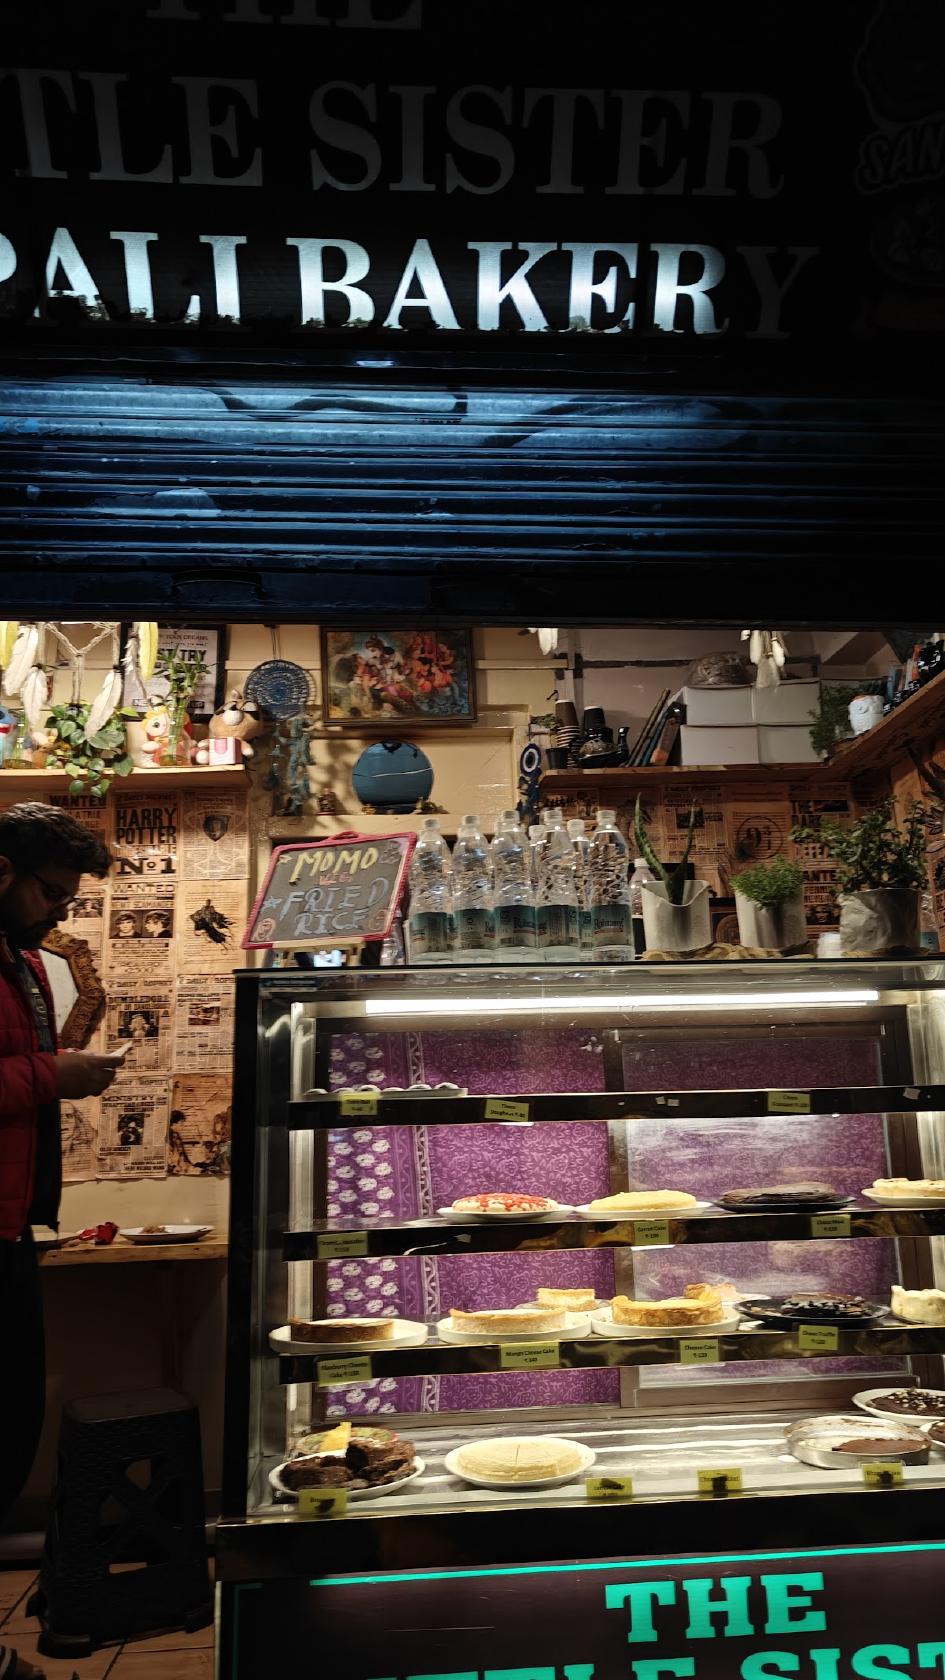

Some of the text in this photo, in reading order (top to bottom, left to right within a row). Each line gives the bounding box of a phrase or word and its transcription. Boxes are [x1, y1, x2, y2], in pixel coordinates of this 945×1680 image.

[0, 66, 785, 200] TLE SISTER
[0, 227, 822, 341] ALI BAKERY
[116, 807, 177, 828] HARRY
[116, 827, 177, 845] POTTER
[289, 847, 379, 886] MOMO
[113, 884, 176, 893] WANTED
[279, 877, 389, 921] FRIED
[294, 907, 369, 937] RICE
[604, 1571, 827, 1643] THE
